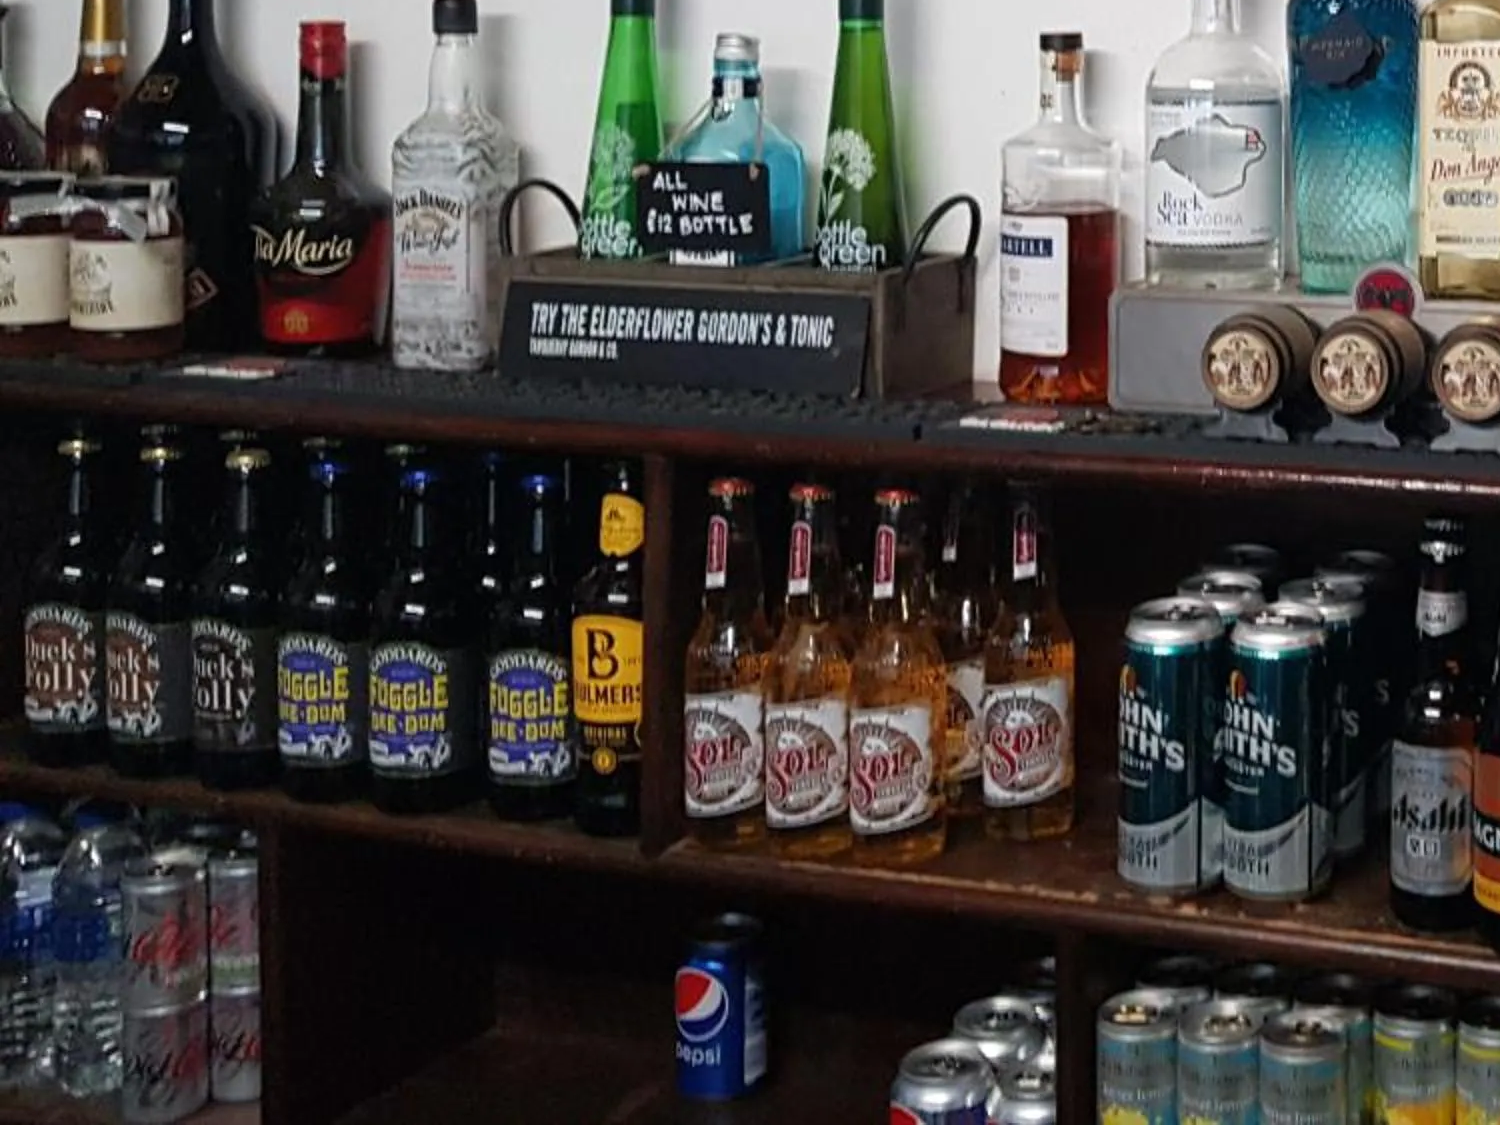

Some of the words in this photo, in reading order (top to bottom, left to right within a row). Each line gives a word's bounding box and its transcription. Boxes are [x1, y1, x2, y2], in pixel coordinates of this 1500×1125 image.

[653, 170, 689, 191] ALL
[672, 191, 725, 213] WINE
[679, 213, 754, 236] BOTTLE
[272, 227, 353, 271] Maria
[819, 242, 887, 271] green
[529, 303, 559, 335] TRY
[560, 304, 589, 336] THE
[589, 306, 695, 342] ELDERFLOWER
[697, 311, 773, 346] GORDON'S
[775, 313, 787, 346] &
[789, 315, 835, 349] TONIC
[370, 674, 449, 712] FUGGLE
[489, 681, 569, 720] FUGGLE
